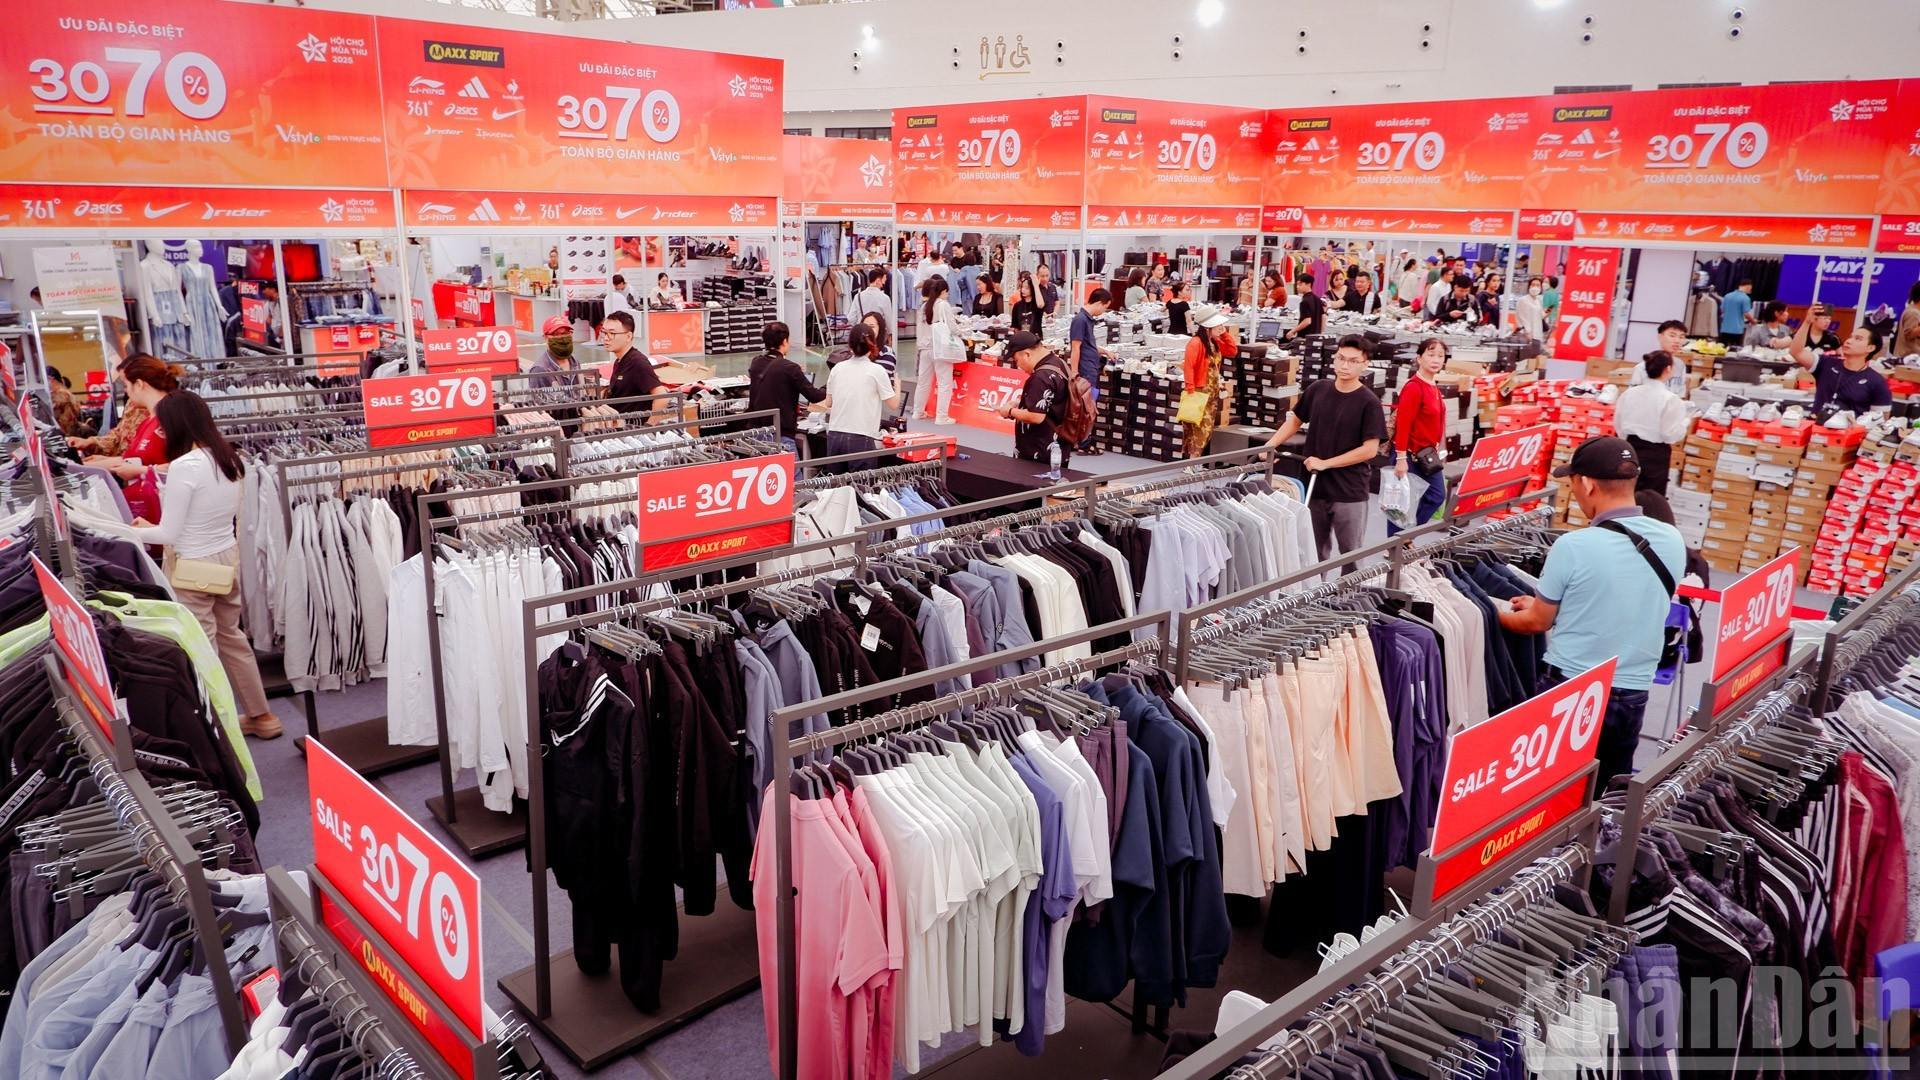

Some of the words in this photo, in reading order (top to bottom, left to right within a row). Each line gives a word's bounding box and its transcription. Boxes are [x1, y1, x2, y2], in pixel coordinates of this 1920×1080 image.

[59, 17, 83, 31] ƯU
[86, 18, 113, 33] ĐÃI
[116, 21, 149, 38] ĐẶC
[152, 24, 184, 40] BIỆT
[352, 48, 368, 57] THU
[469, 50, 499, 62] SPORT
[579, 62, 594, 73] ƯU
[596, 63, 613, 75] ĐÃI
[614, 66, 635, 79] ĐẶC
[637, 67, 658, 81] BIỆT
[38, 120, 94, 139] TOÀN
[98, 122, 126, 143] BỘ
[130, 127, 177, 142] GIAN
[180, 125, 231, 143] HÀNG
[560, 143, 594, 159] TOÀN
[597, 145, 614, 162] BỘ
[616, 149, 645, 161] GIAN
[647, 147, 681, 162] HÀNG
[957, 170, 975, 180] TOÀN
[986, 171, 1000, 180] GIAN
[1001, 170, 1020, 180] HÀNG
[1644, 172, 1673, 184] TOÀN
[1677, 173, 1693, 186] BỘ
[1695, 174, 1725, 185] GIAN
[1726, 172, 1761, 185] HÀNG
[1570, 290, 1606, 304] SALE
[428, 342, 452, 352] SALE
[371, 395, 404, 408] SALE
[436, 427, 458, 437] SPORT
[1471, 456, 1493, 470] SALE
[647, 494, 687, 513] SALE
[687, 542, 721, 559] MAXX
[721, 535, 748, 549] SPORT
[1720, 613, 1743, 643] SALE
[1451, 759, 1499, 803] SALE
[315, 797, 353, 852] SALE
[1480, 826, 1517, 866] MAXX
[1516, 809, 1547, 841] SPORT
[362, 939, 397, 994] MAXX
[397, 986, 428, 1027] SPORT
